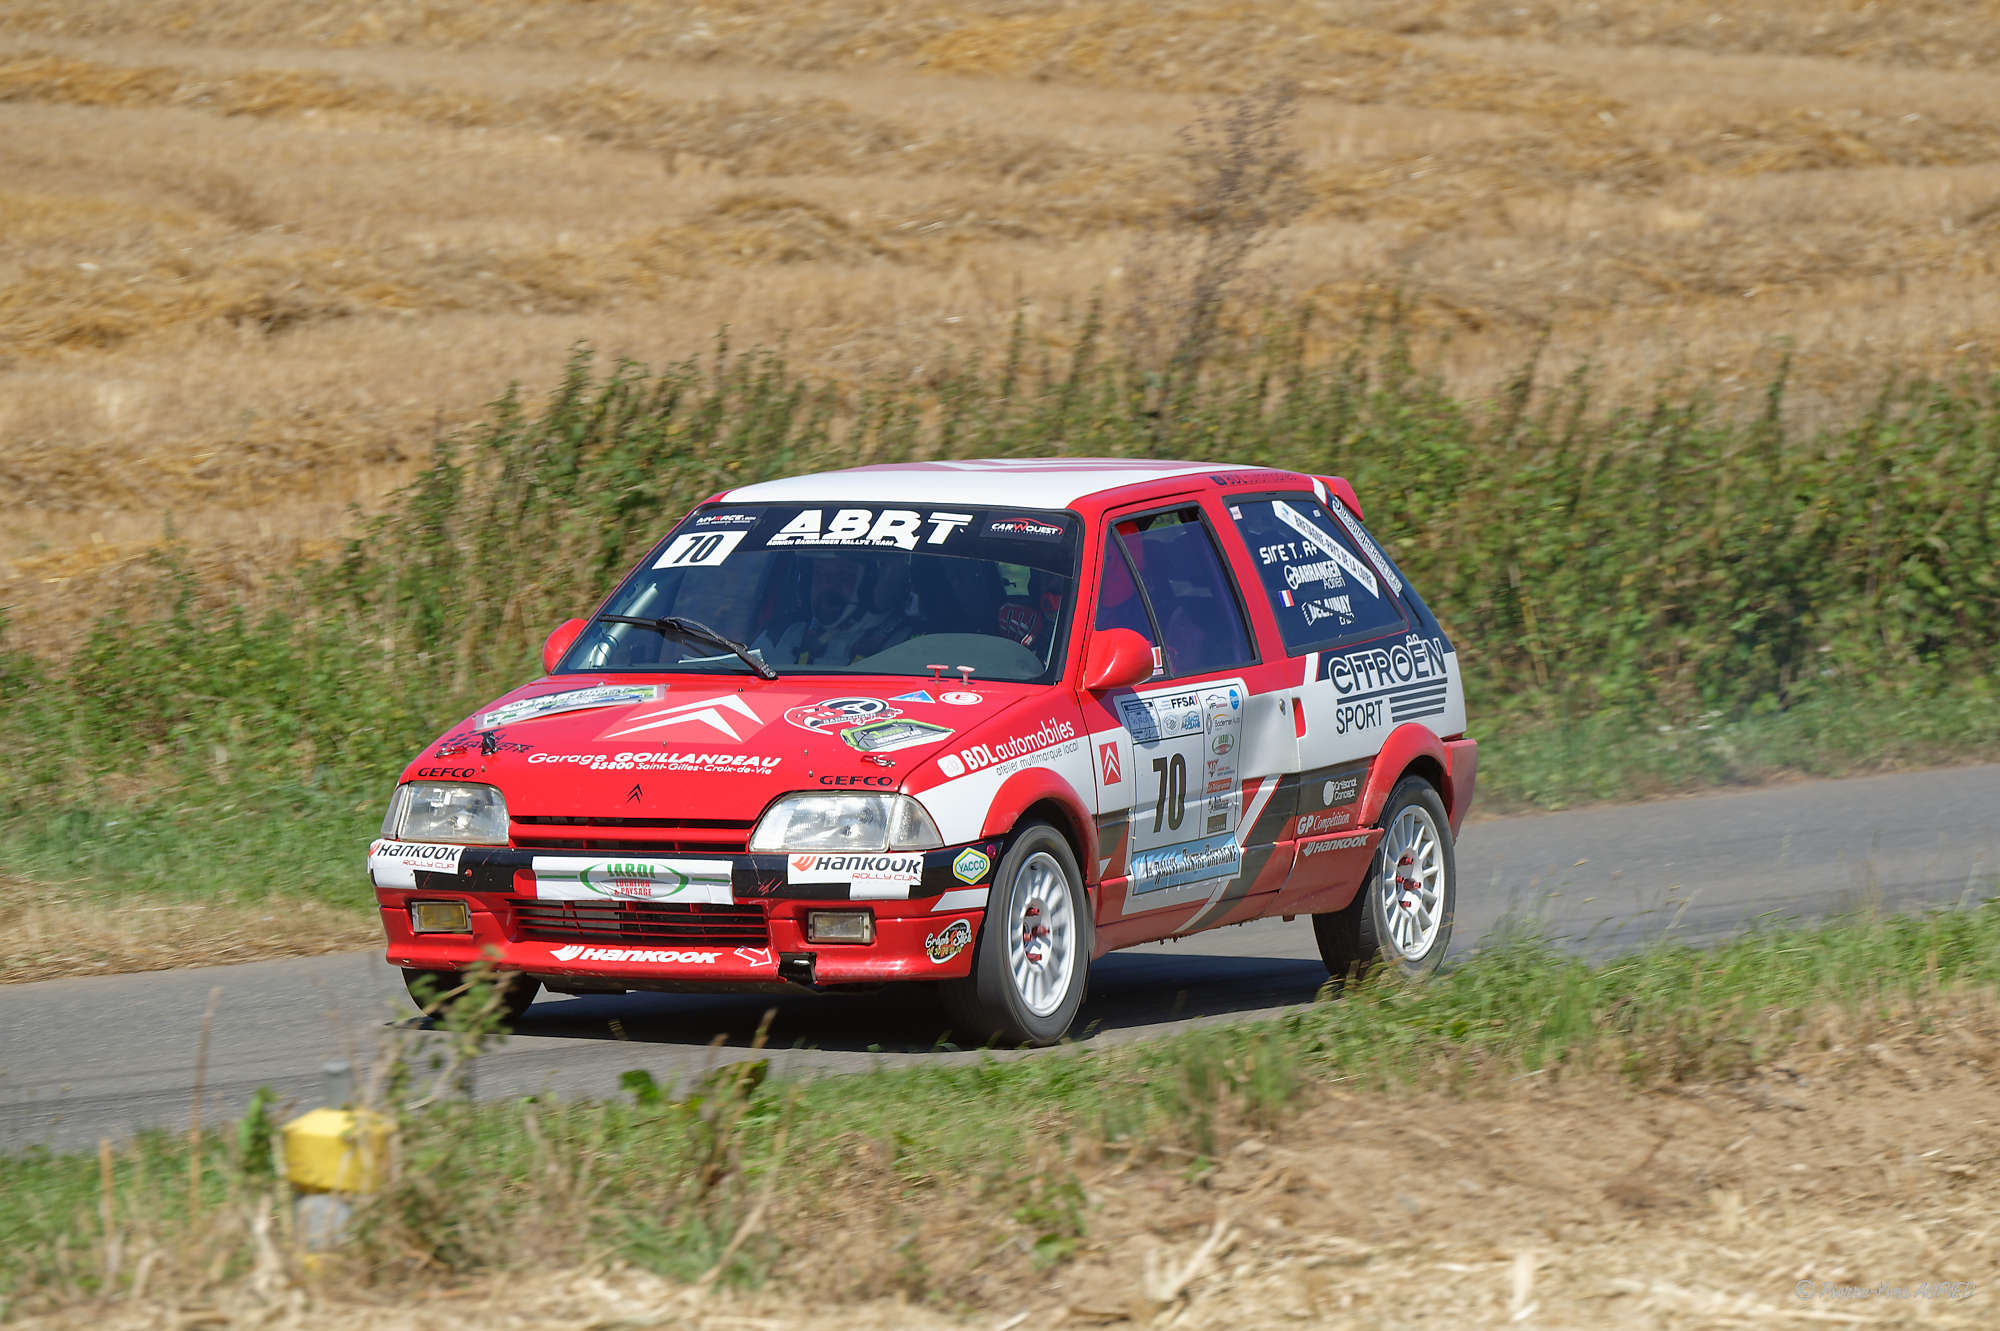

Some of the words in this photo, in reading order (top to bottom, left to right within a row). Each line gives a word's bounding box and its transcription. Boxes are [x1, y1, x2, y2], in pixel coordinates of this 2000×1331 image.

[768, 509, 974, 550] ABRT
[672, 534, 725, 564] 70
[1328, 634, 1447, 695] CITROËN
[1171, 696, 1194, 708] FFSA
[1336, 700, 1383, 735] SPORT
[528, 753, 606, 765] Garage
[614, 752, 782, 768] GOILLANDEAU
[590, 761, 634, 770] 85800
[417, 767, 475, 778] GEFCO
[819, 775, 893, 786] GEFCO
[1152, 753, 1187, 832] 70
[1297, 815, 1314, 834] GP
[959, 860, 985, 872] YACCO
[621, 888, 652, 896] PAYSAGE
